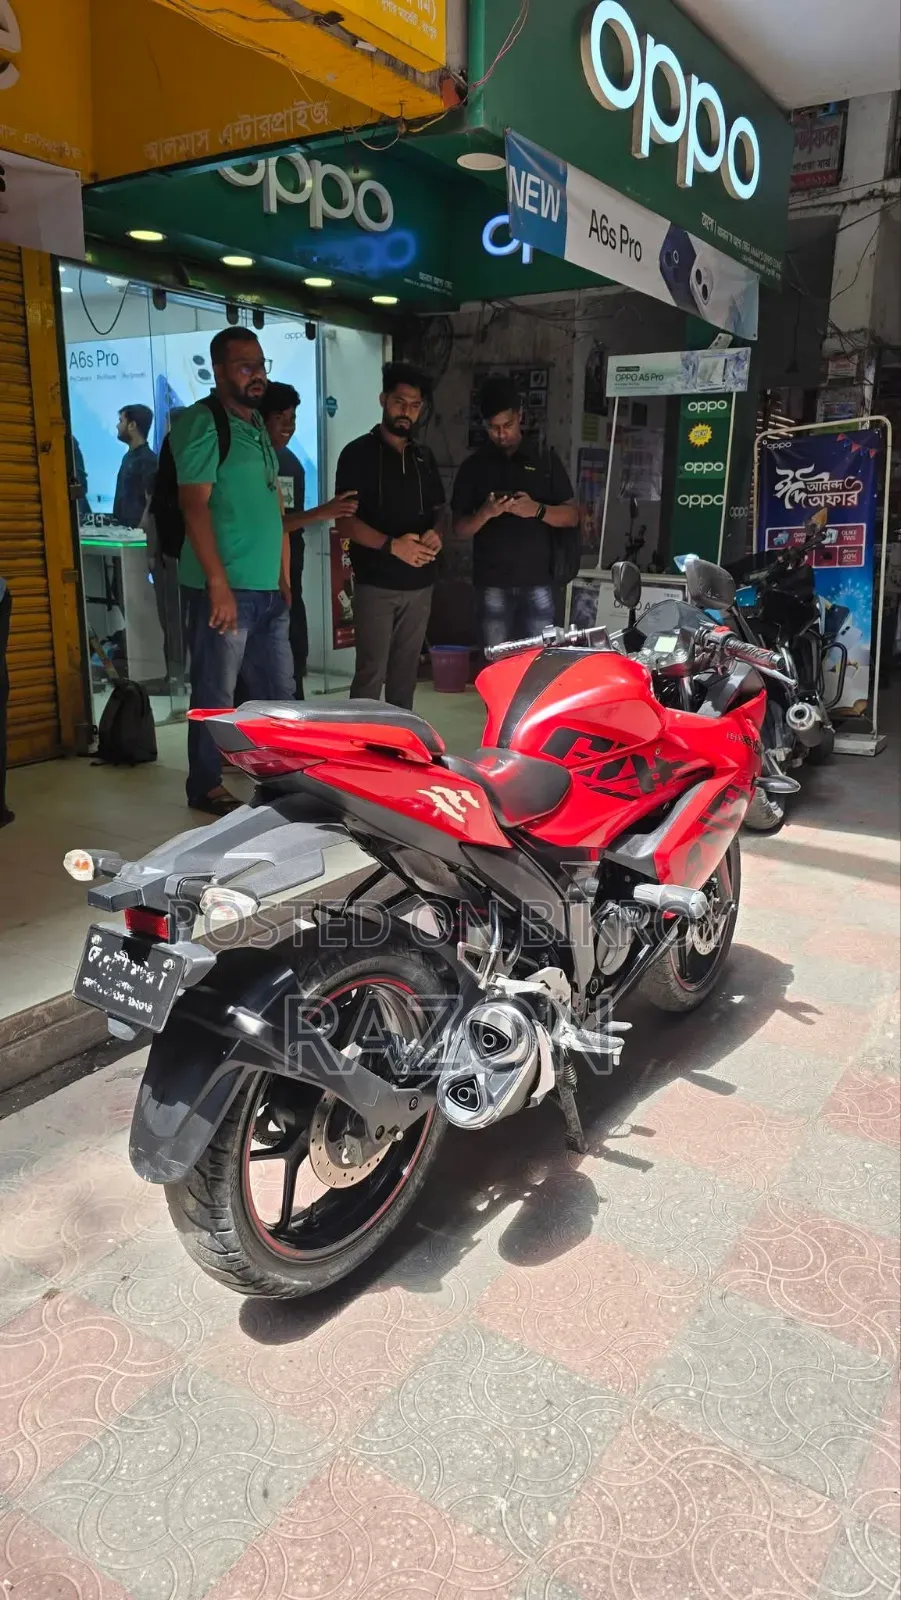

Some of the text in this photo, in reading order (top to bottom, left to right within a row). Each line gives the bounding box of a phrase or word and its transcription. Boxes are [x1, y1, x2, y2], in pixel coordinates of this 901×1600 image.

[581, 0, 760, 199] oppo
[509, 165, 561, 223] NEW
[588, 208, 642, 262] A6s Pro
[69, 349, 119, 369] A6s Pro
[687, 400, 728, 413] oppo
[767, 441, 792, 450] oppo
[684, 462, 724, 474] oppo
[806, 479, 844, 492] আনন্দ
[677, 494, 725, 509] oppo
[807, 490, 860, 507] অফার
